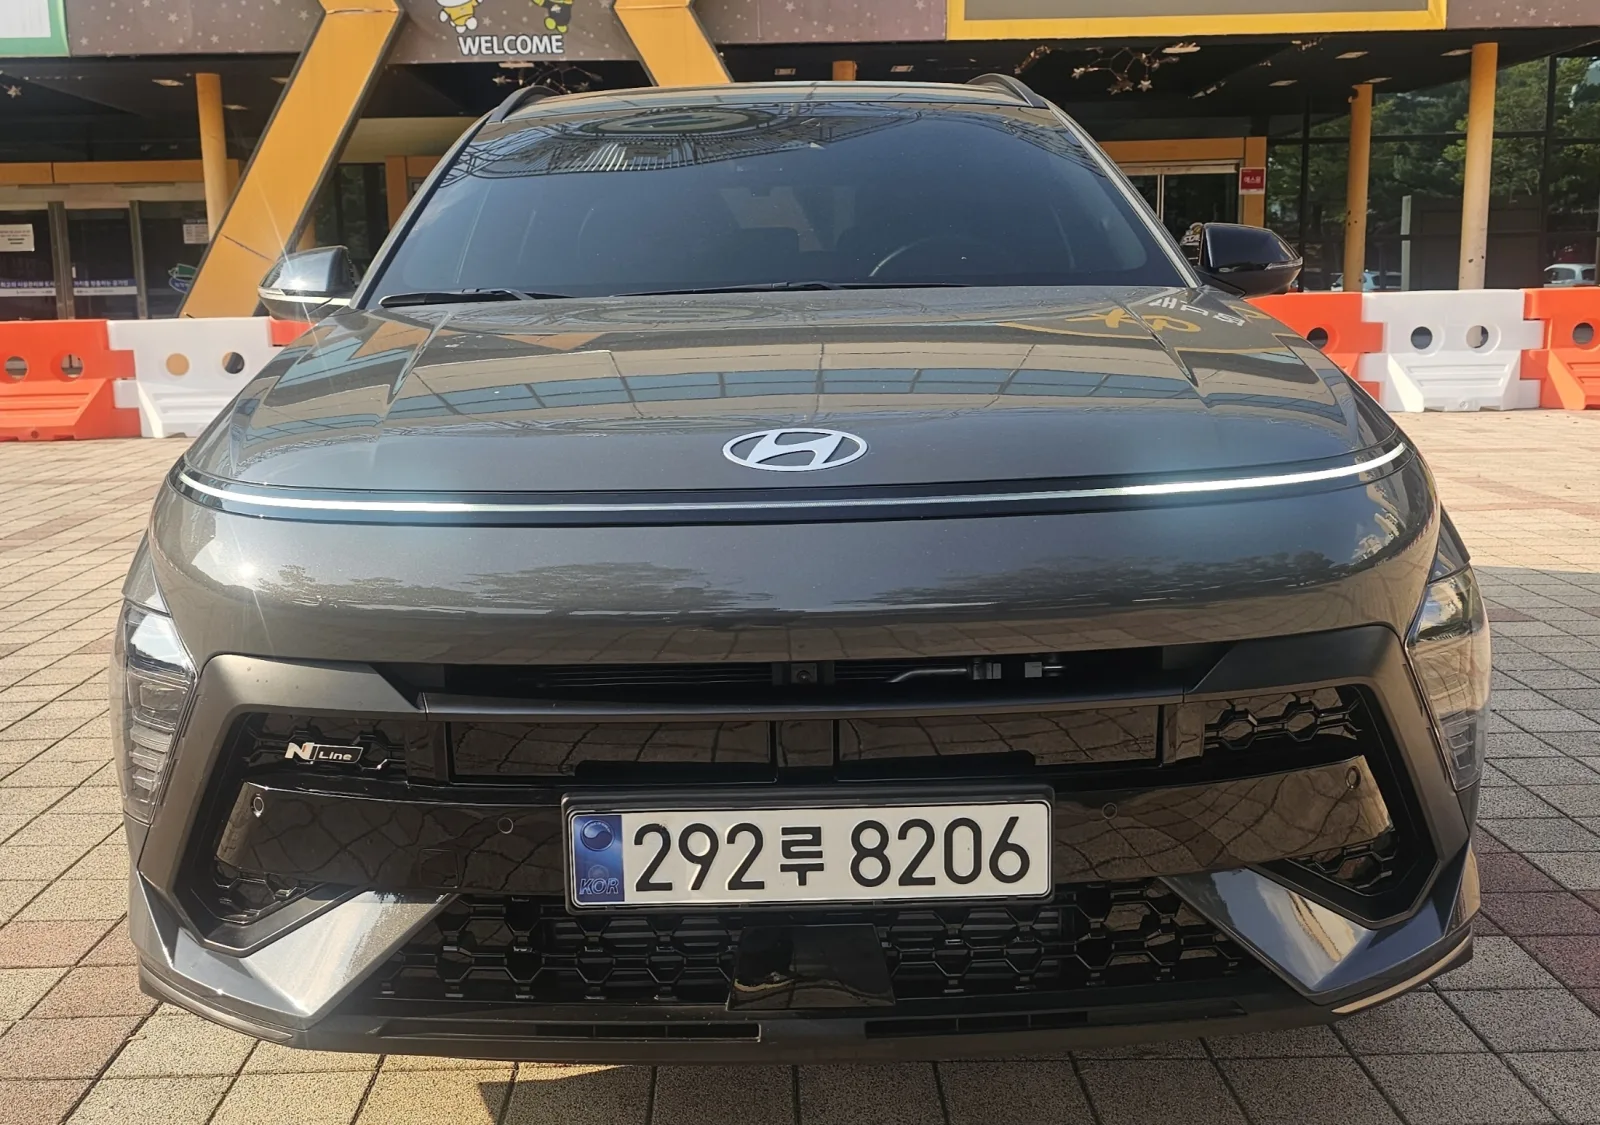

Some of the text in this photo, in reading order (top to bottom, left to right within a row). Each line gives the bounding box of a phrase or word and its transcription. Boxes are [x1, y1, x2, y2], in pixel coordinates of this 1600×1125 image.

[458, 34, 564, 55] WELCOME
[849, 815, 1031, 888] 8206
[579, 877, 620, 895] KOR
